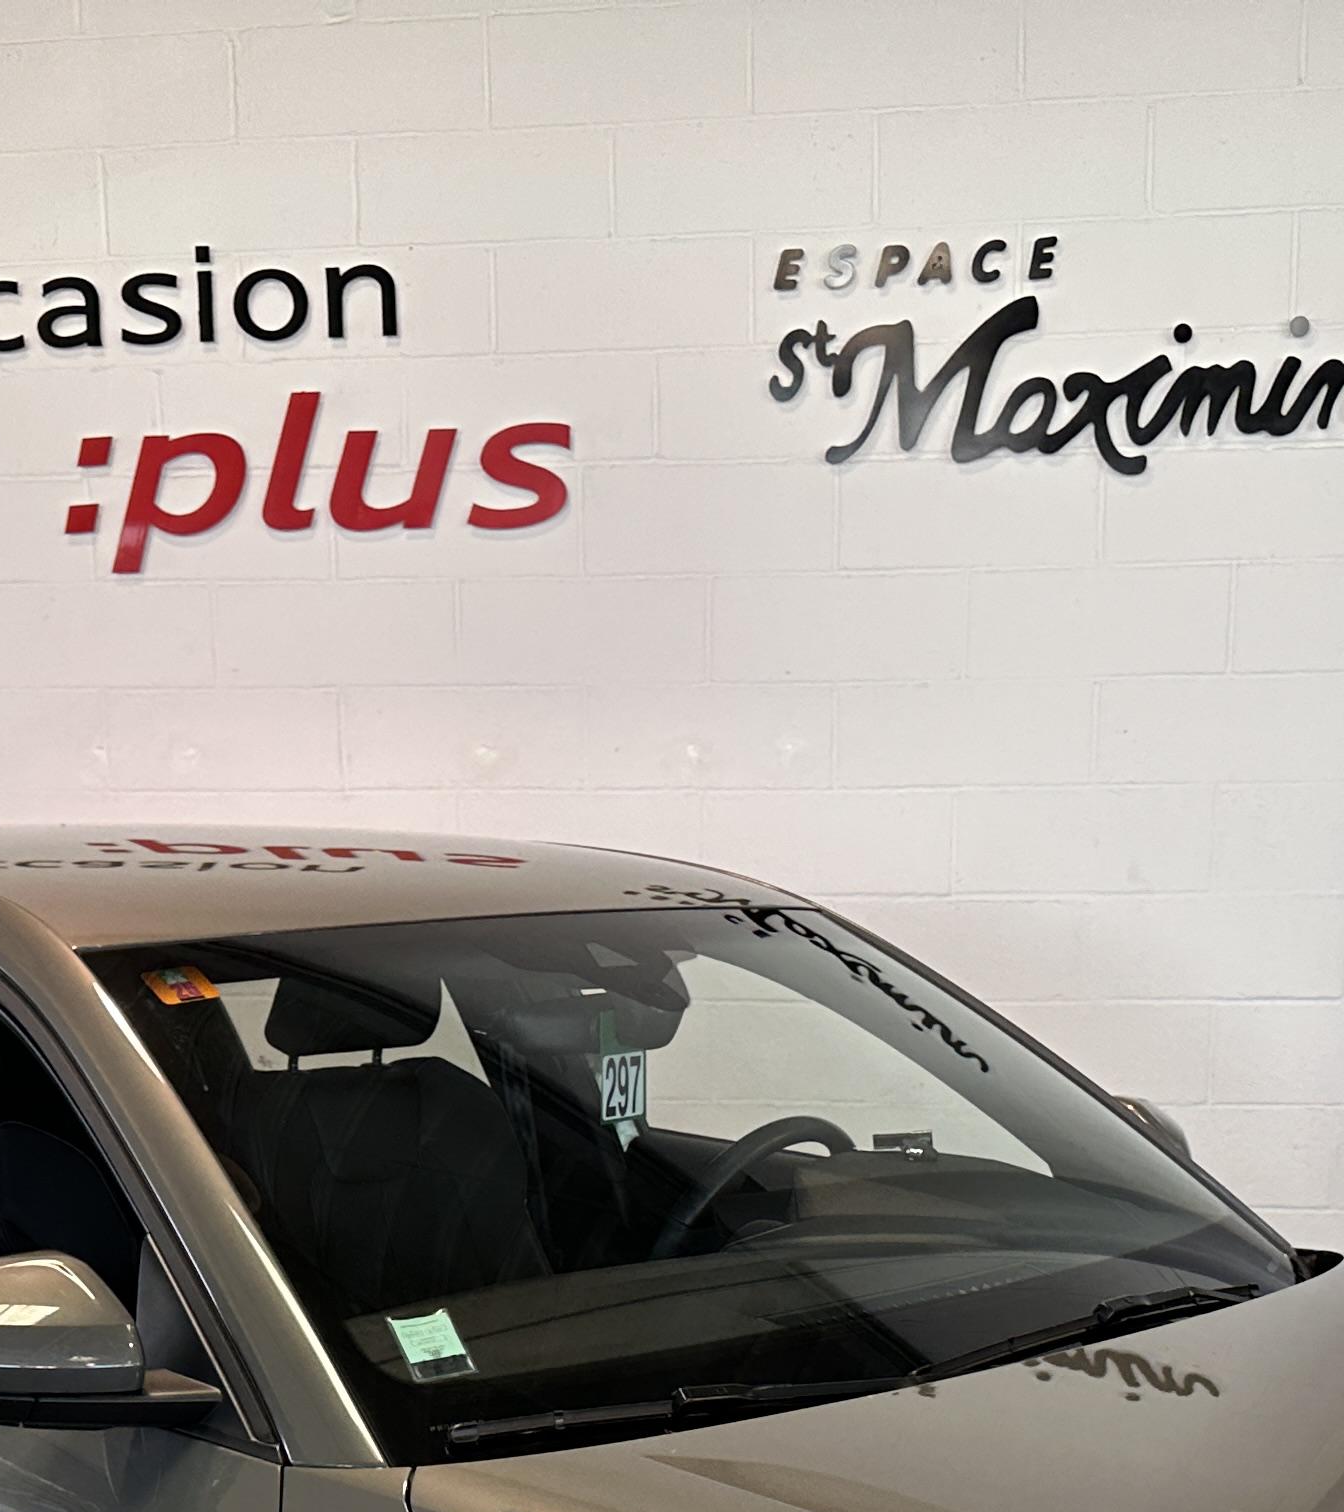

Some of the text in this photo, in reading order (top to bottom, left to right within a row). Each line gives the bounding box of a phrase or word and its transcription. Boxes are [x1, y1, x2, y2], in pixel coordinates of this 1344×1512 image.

[773, 236, 1058, 291] ESPACE
[769, 319, 836, 401] St
[64, 391, 573, 575] :plus
[605, 1055, 642, 1118] 297
